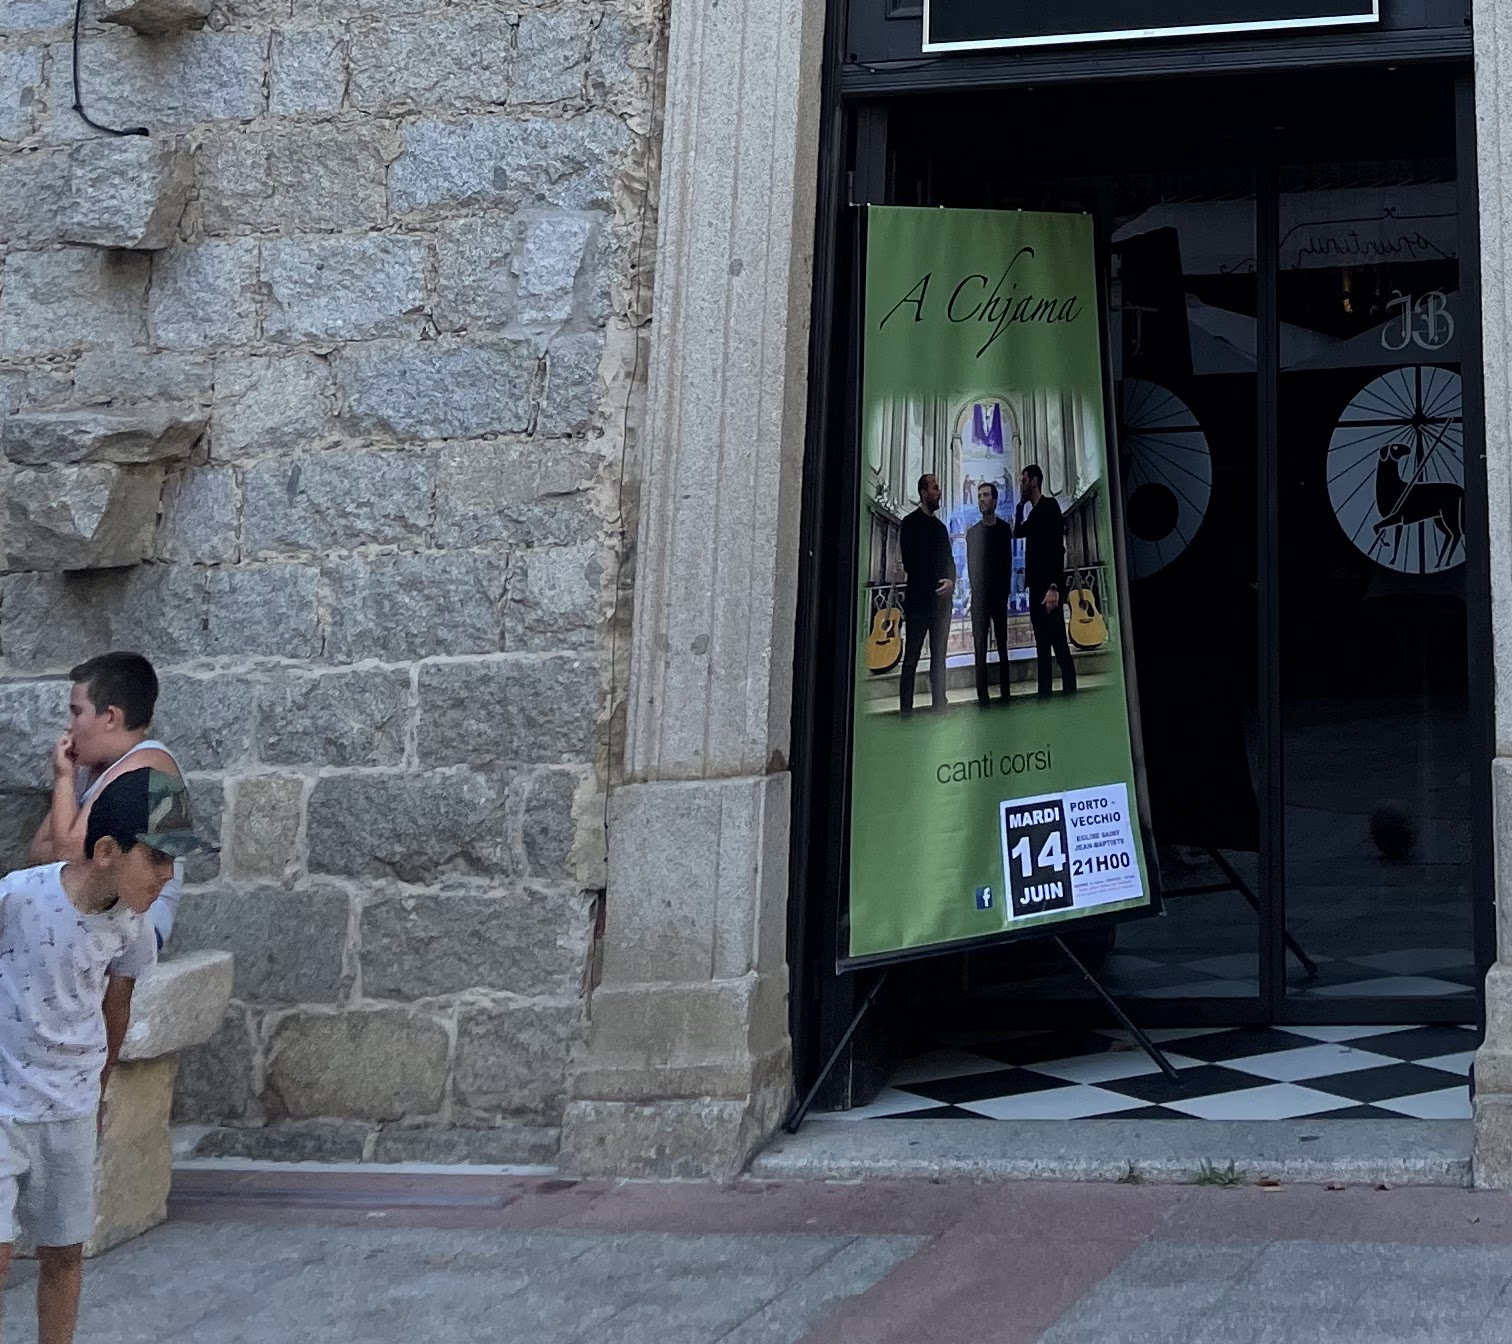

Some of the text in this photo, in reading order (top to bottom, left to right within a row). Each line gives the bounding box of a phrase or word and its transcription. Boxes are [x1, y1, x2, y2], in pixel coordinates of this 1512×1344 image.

[879, 271, 932, 330] A
[947, 246, 1083, 359] Chjama
[936, 743, 1051, 783] canti corsi
[1070, 798, 1108, 812] PORTO
[1009, 807, 1060, 829] MARDI
[1070, 812, 1121, 828] VECCHIO
[1011, 831, 1066, 878] 14
[1072, 851, 1130, 876] 21H00
[1019, 881, 1064, 905] JUIN
